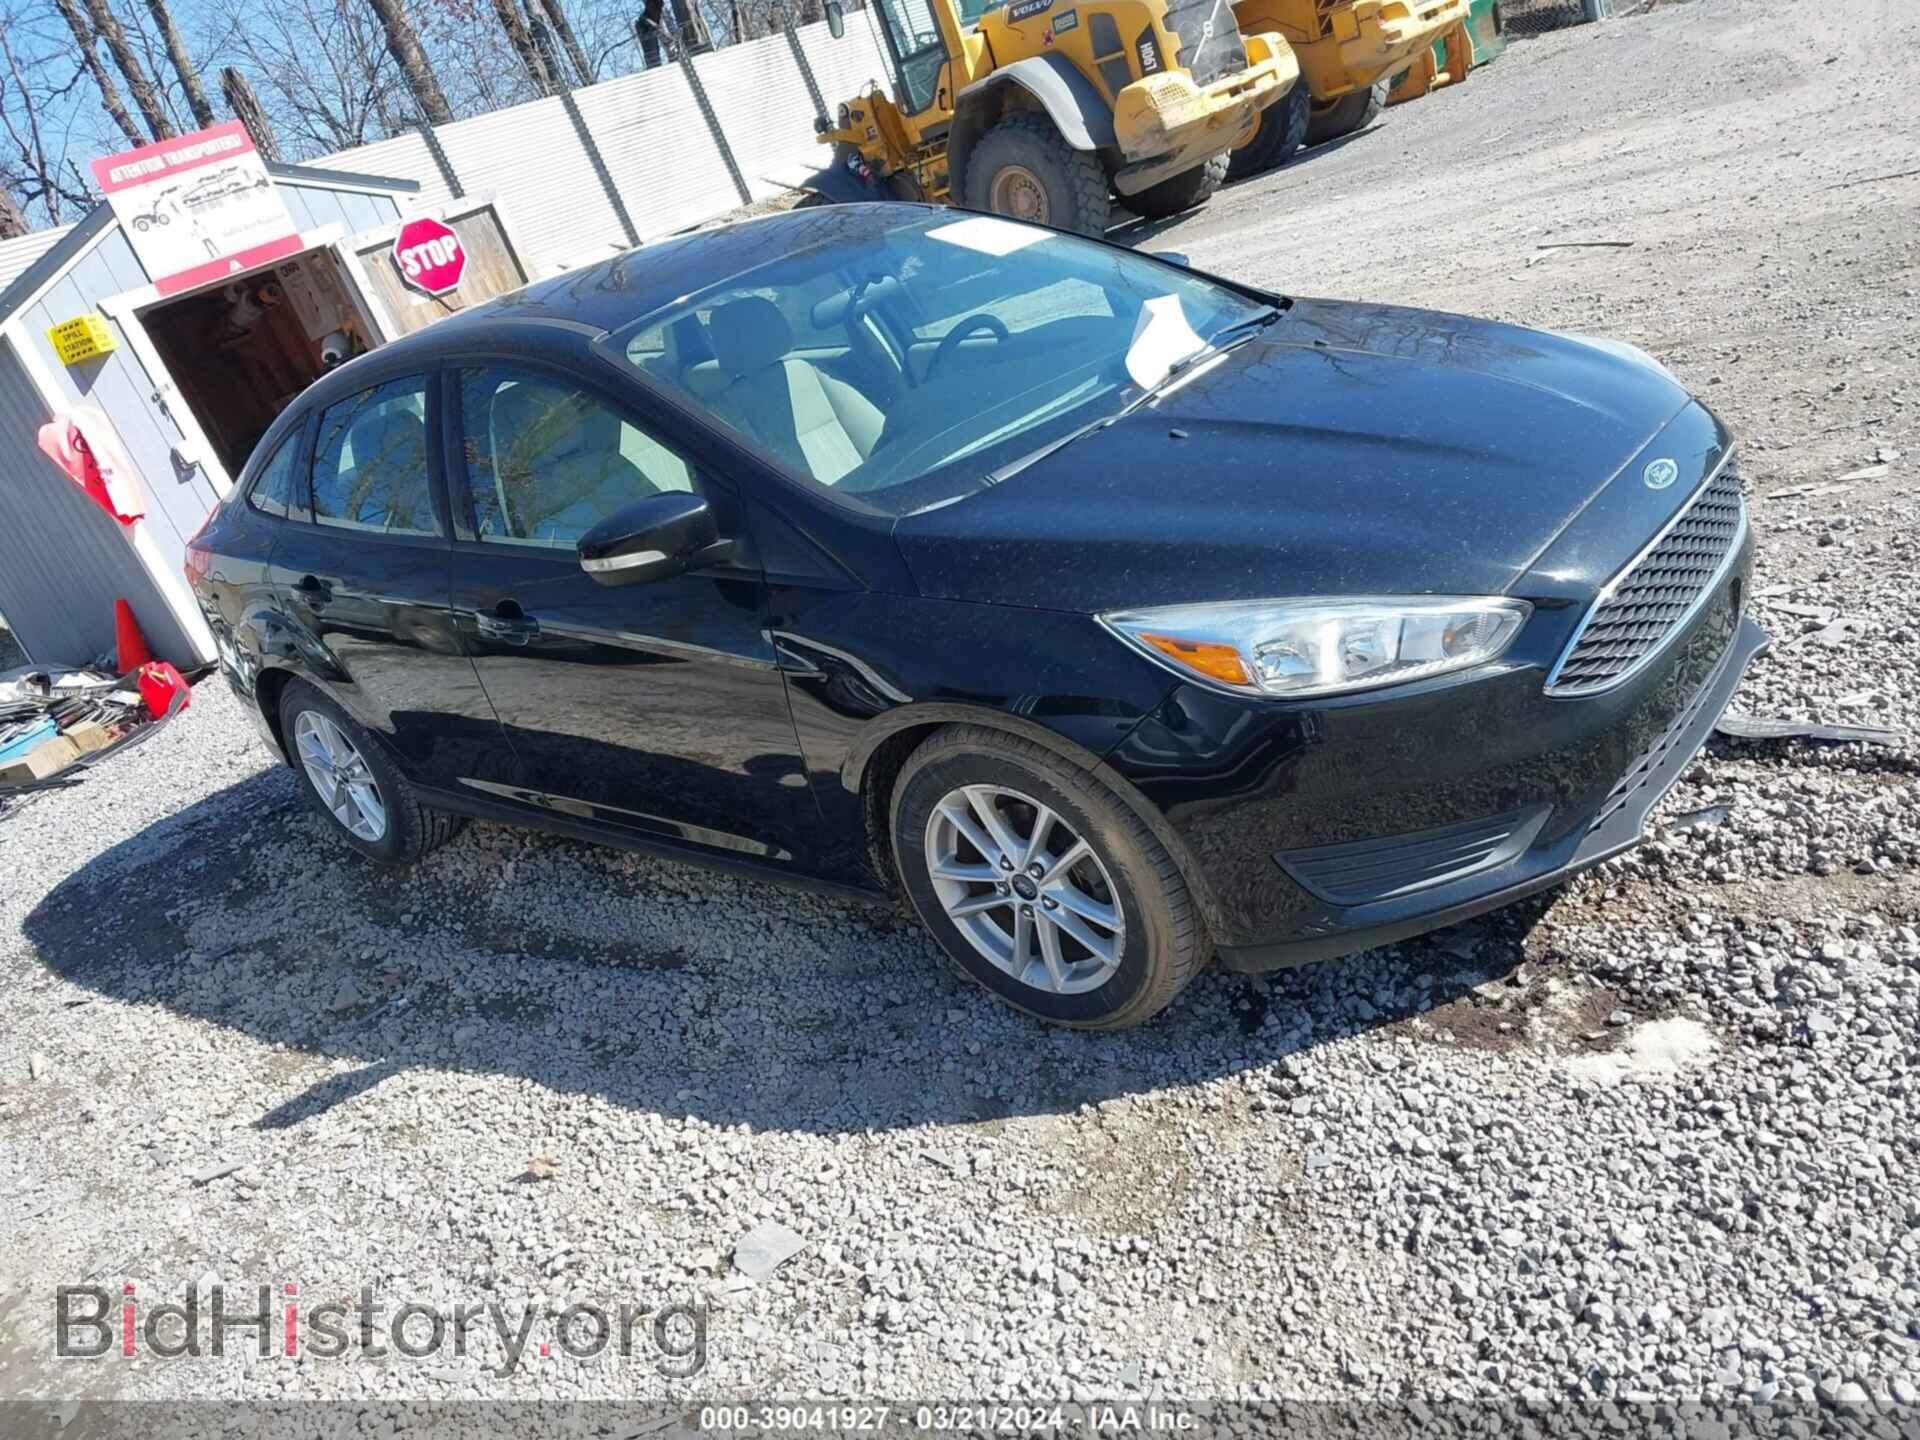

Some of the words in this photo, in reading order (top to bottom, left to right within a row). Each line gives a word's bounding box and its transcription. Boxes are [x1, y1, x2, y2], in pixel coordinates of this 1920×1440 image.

[1012, 0, 1053, 17] VOLVO
[1140, 41, 1158, 72] L90H
[108, 156, 165, 184] ATTENTION
[401, 234, 458, 277] STOP
[63, 330, 83, 342] SPILL
[63, 337, 94, 353] STATION
